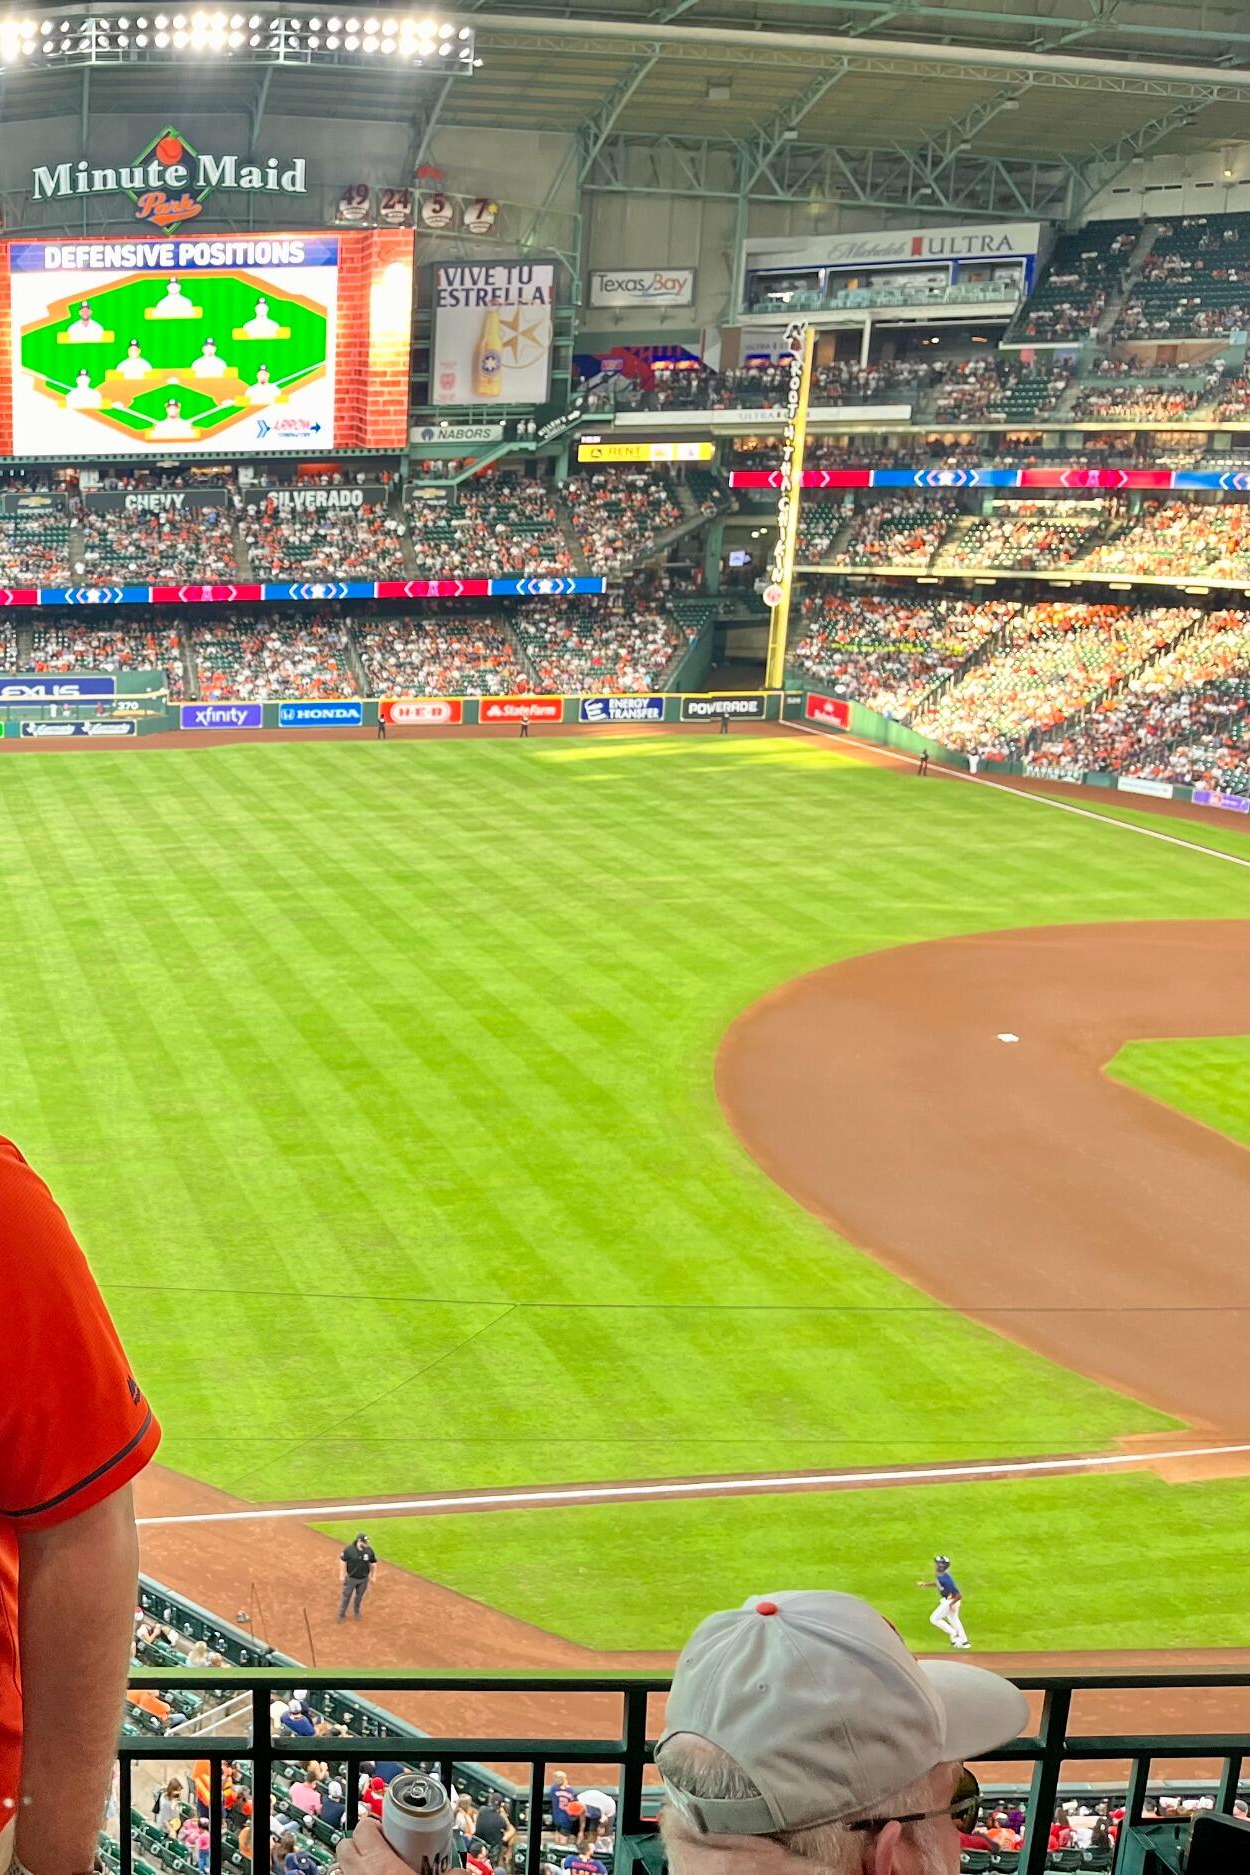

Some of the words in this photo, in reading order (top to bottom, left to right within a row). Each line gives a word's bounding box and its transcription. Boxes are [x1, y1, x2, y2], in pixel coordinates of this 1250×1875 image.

[32, 159, 188, 199] Minute
[196, 155, 308, 193] Maid
[342, 184, 369, 206] 49
[382, 188, 411, 209] 24
[432, 193, 447, 214] 5
[136, 191, 202, 224] Park
[474, 198, 488, 219] 7
[928, 234, 1014, 255] ULTRA
[45, 244, 175, 269] DEFENSIVE
[179, 241, 305, 266] POSITIONS
[503, 266, 533, 285] TU
[598, 274, 646, 293] Texas
[654, 273, 687, 297] Bay
[438, 424, 491, 439] NABORS
[125, 494, 185, 510] CHEVY
[268, 490, 364, 507] SILVERADO
[118, 701, 139, 710] 370
[608, 698, 650, 709] ENERGY
[688, 700, 758, 715] POWERADE
[195, 707, 247, 726] xfinity
[297, 708, 359, 719] HONDA
[609, 708, 659, 719] TRANSFER
